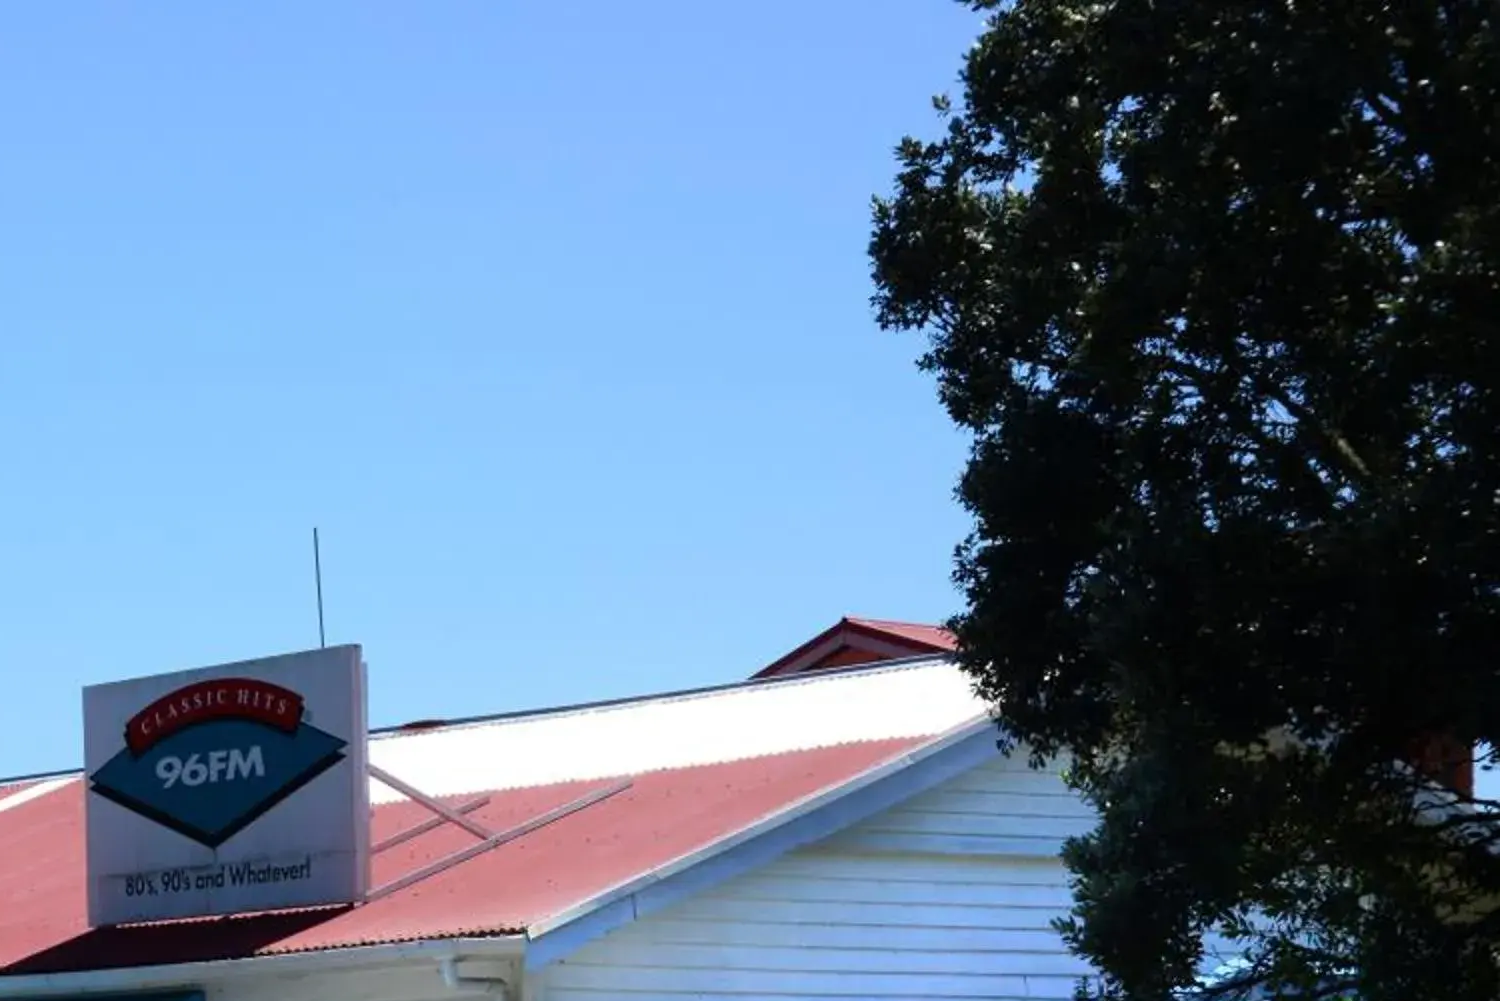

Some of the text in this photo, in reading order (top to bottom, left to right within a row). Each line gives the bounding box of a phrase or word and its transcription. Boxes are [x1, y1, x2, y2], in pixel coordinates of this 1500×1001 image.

[140, 688, 288, 735] CLASSIC HITS
[155, 745, 266, 790] 96FM
[161, 869, 190, 893] 90's
[195, 864, 224, 890] and
[228, 855, 312, 888] Whatever!
